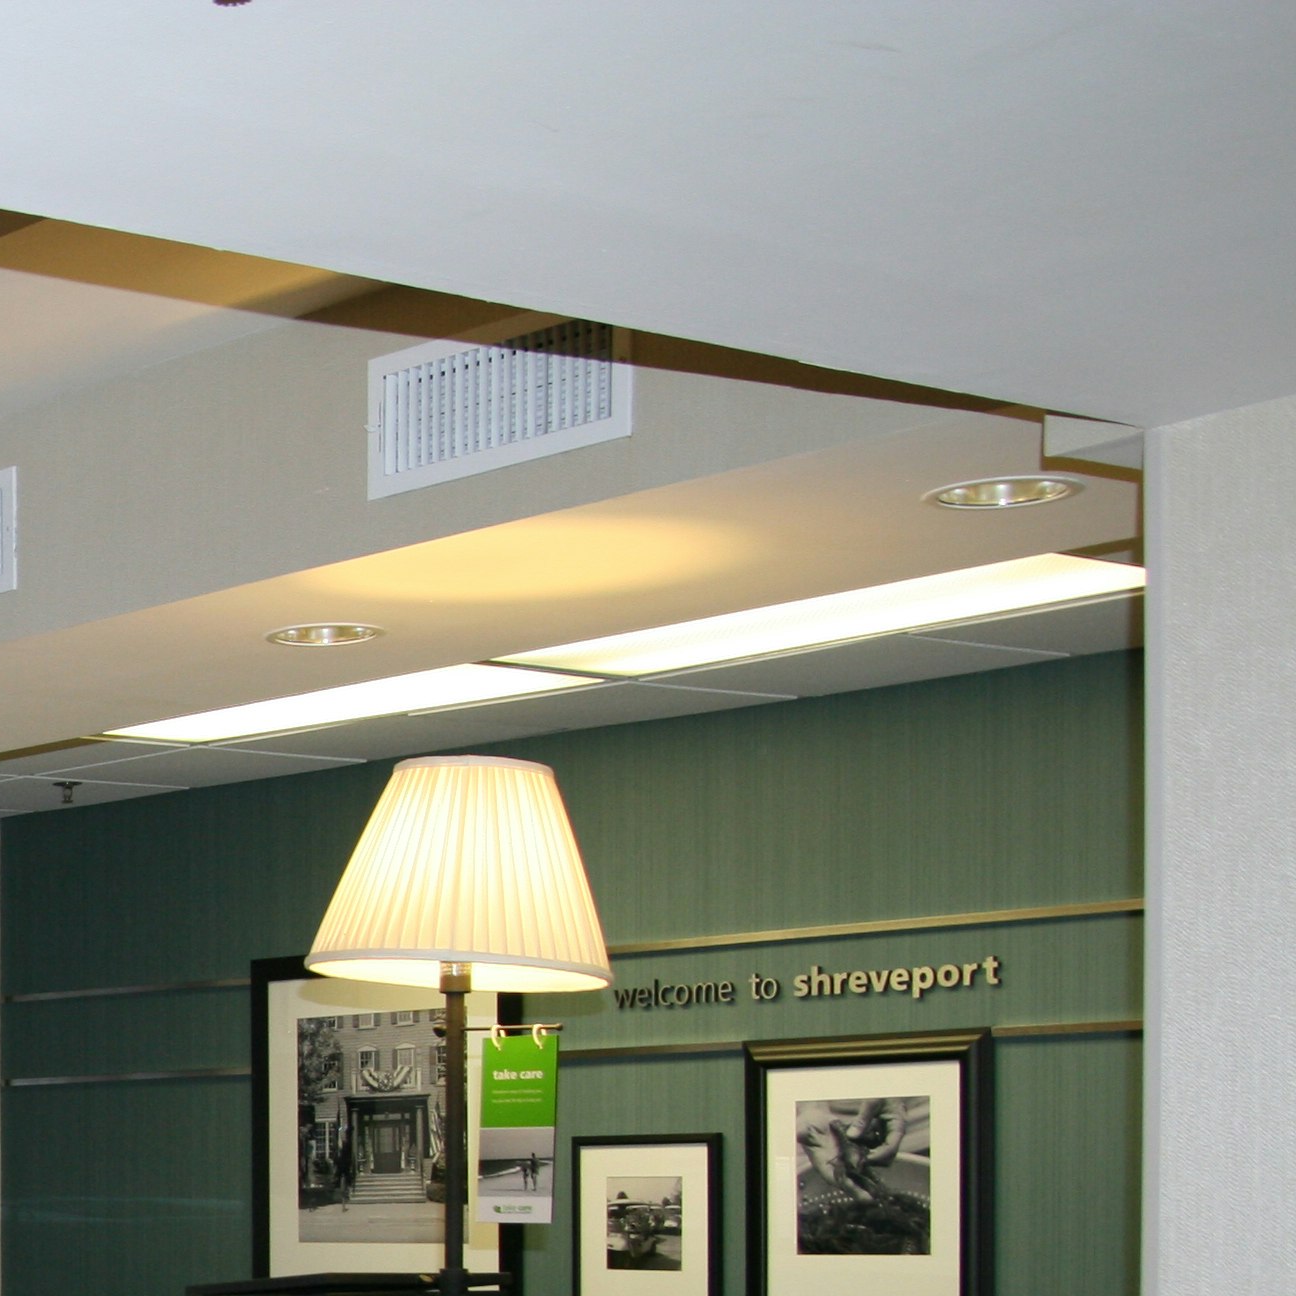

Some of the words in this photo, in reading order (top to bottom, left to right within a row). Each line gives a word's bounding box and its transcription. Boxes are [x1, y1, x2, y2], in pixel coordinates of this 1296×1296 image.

[614, 978, 735, 1009] welcome
[748, 973, 779, 1000] to
[793, 955, 1000, 998] shreveport
[492, 1069, 517, 1080] take
[520, 1070, 544, 1079] care
